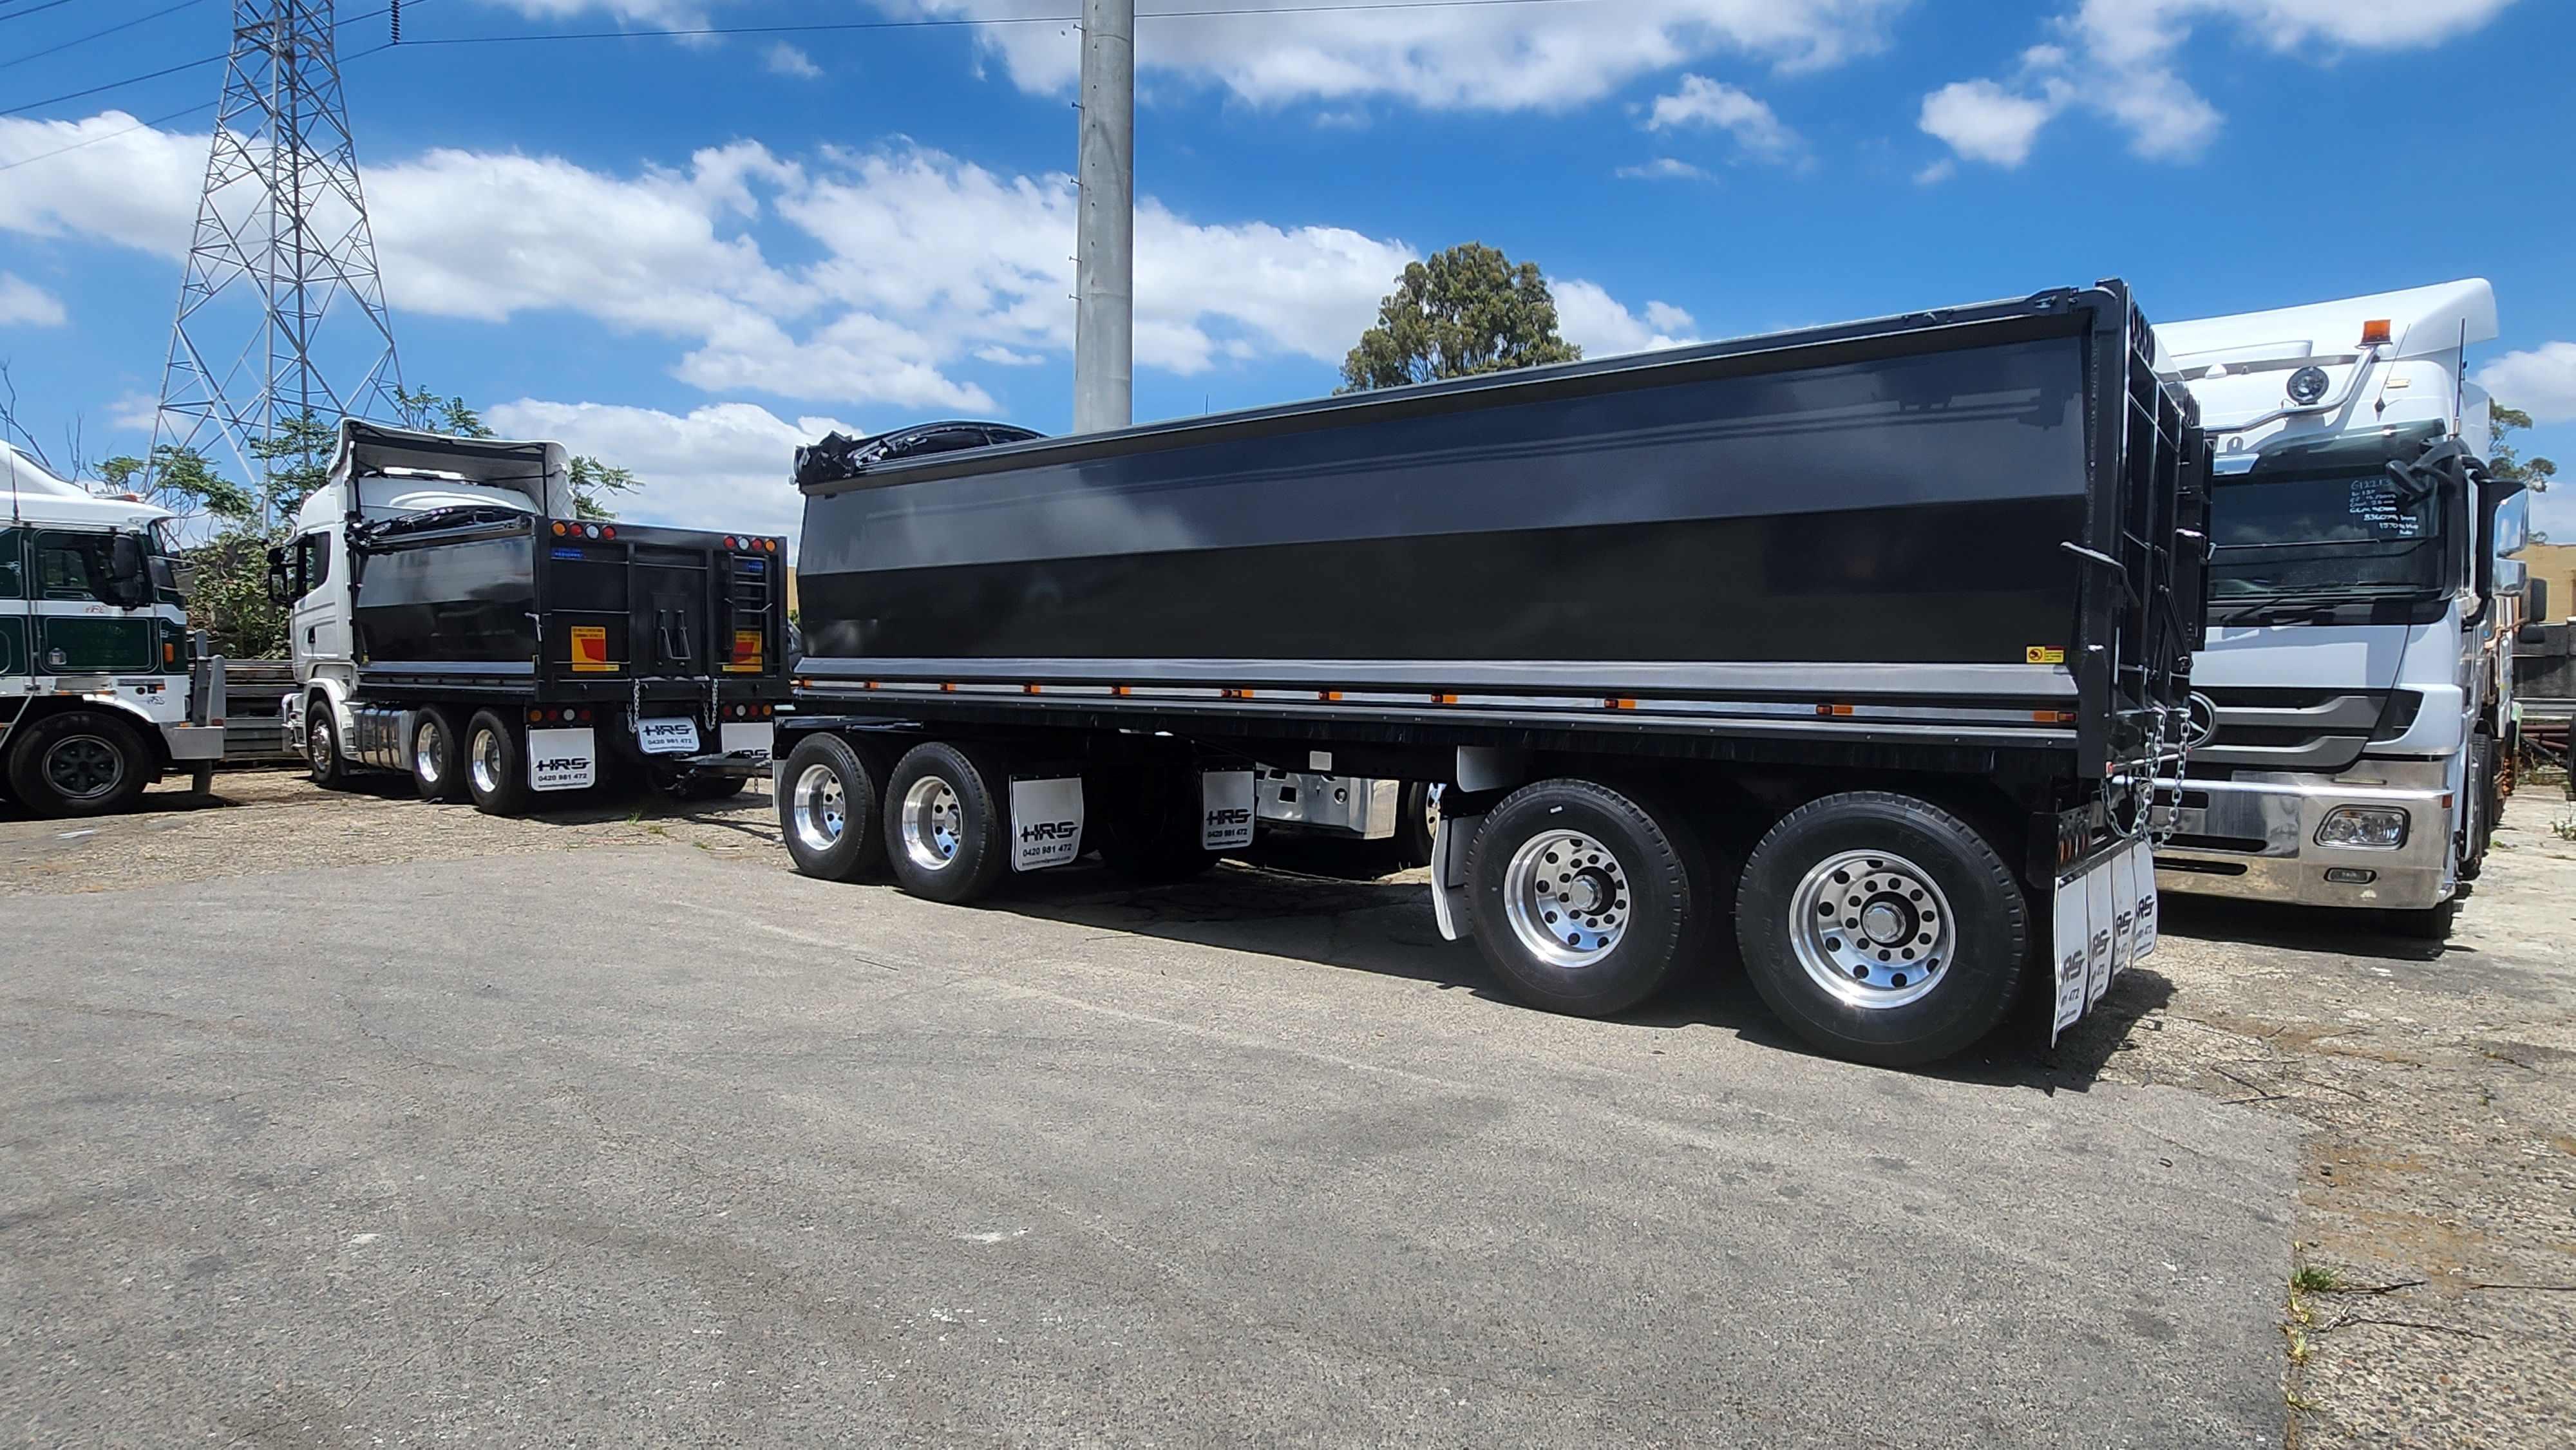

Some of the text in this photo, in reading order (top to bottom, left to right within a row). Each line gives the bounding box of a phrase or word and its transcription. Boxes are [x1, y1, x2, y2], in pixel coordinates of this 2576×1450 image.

[643, 724, 692, 736] HRS
[535, 758, 592, 772] HRS
[1206, 809, 1251, 826] HRS
[1020, 821, 1079, 843] HRS
[1023, 843, 1072, 858] 0420 981 472
[2092, 928, 2111, 959] RS
